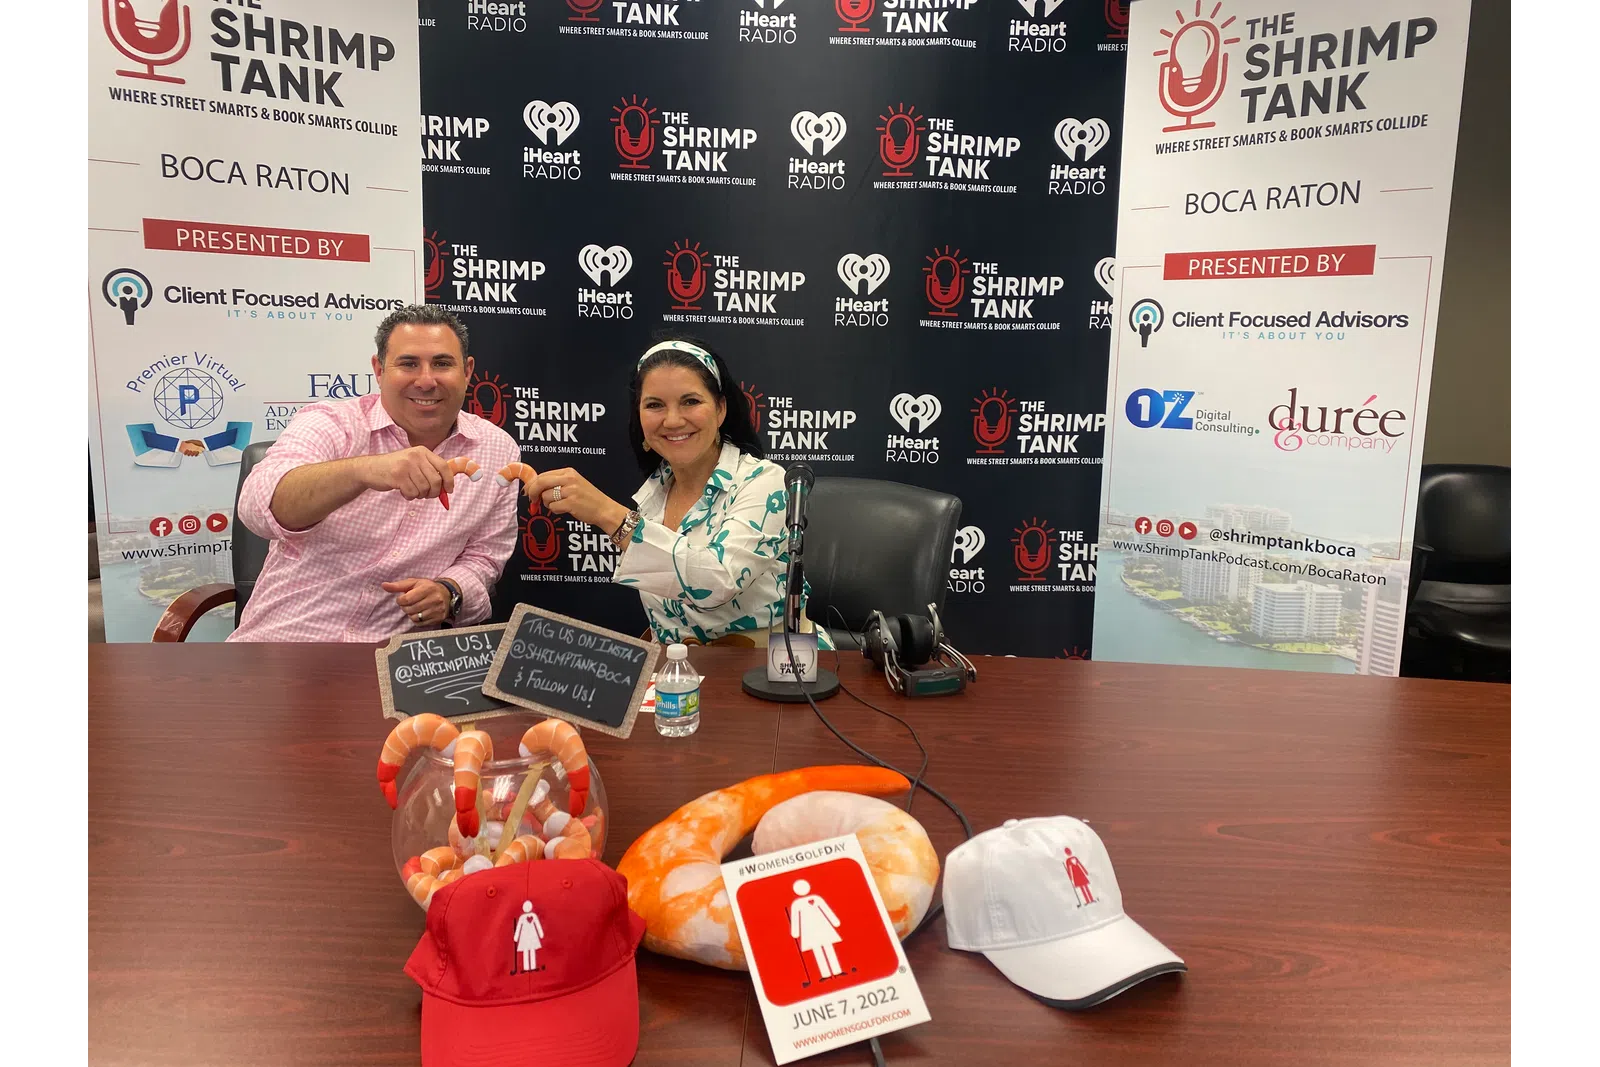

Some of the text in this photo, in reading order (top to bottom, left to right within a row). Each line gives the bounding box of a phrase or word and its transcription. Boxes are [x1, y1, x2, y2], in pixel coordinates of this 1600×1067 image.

[468, 0, 526, 16] iHeart
[612, 1, 680, 25] TANK
[467, 15, 527, 33] RADIO
[740, 9, 796, 29] iHeart
[882, 11, 949, 33] TANK
[1010, 19, 1067, 37] iHeart
[1246, 11, 1295, 40] THE
[210, 7, 396, 72] SHRIMP
[739, 27, 797, 44] RADIO
[829, 36, 851, 45] WHERE
[852, 37, 875, 46] STREET
[876, 37, 900, 46] SMARTS
[908, 38, 925, 46] BOOK
[926, 37, 950, 46] SMARTS
[952, 38, 977, 48] COLLIDE
[1008, 37, 1067, 52] RADIO
[1243, 16, 1438, 81] SHRIMP
[210, 51, 345, 108] TANK
[1240, 71, 1370, 124] TANK
[108, 86, 157, 106] WHERE
[160, 93, 206, 112] STREET
[209, 100, 258, 119] SMARTS
[273, 108, 305, 125] BOOK
[308, 114, 353, 131] SMARTS
[355, 119, 398, 137] COLLIDE
[662, 111, 689, 124] THE
[928, 117, 954, 131] THE
[662, 126, 758, 150] SHRIMP
[1155, 140, 1191, 155] WHERE
[1193, 136, 1231, 152] STREET
[1232, 131, 1277, 148] SMARTS
[1290, 125, 1322, 142] BOOK
[1325, 120, 1374, 138] SMARTS
[1376, 114, 1429, 132] COLLIDE
[926, 132, 1021, 158] SHRIMP
[523, 147, 580, 165] iHeart
[662, 150, 728, 173] TANK
[161, 153, 350, 196] BOCA RATON
[440, 165, 465, 174] SMARTS
[466, 166, 491, 175] COLLIDE
[523, 164, 581, 181] RADIO
[789, 157, 845, 175] iHeart
[925, 156, 991, 180] TANK
[1050, 164, 1106, 180] iHeart
[788, 174, 846, 190] RADIO
[873, 180, 895, 189] WHERE
[896, 181, 918, 189] STREET
[918, 181, 942, 190] SMARTS
[950, 182, 966, 191] BOOK
[967, 183, 991, 192] SMARTS
[992, 184, 1017, 194] COLLIDE
[1048, 179, 1106, 195] RADIO
[1185, 180, 1361, 215] BOCA RATON
[176, 228, 344, 257] PRESENTED BY
[451, 244, 478, 256] THE
[452, 258, 546, 281] SHRIMP
[713, 255, 739, 267] THE
[972, 262, 998, 275] THE
[1188, 253, 1346, 276] PRESENTED BY
[714, 269, 806, 291] SHRIMP
[972, 276, 1064, 297] SHRIMP
[164, 285, 404, 312] Client Focused Advisors
[452, 280, 517, 302] TANK
[578, 288, 632, 305] iHeart
[713, 291, 777, 313] TANK
[835, 297, 888, 313] iHeart
[970, 298, 1034, 319] TANK
[267, 310, 316, 320] ABOUT
[325, 312, 353, 321] YOU
[578, 304, 634, 320] RADIO
[662, 314, 684, 322] WHERE
[685, 315, 707, 323] STREET
[708, 315, 731, 323] SMARTS
[756, 317, 779, 325] SMARTS
[780, 318, 804, 326] COLLIDE
[834, 313, 889, 327] RADIO
[1172, 310, 1409, 328] Client Focused Advisors
[1258, 332, 1306, 341] ABOUT
[1315, 332, 1346, 341] YOU
[126, 351, 247, 393] Premier Virtual
[513, 387, 539, 399] THE
[768, 396, 793, 408] THE
[515, 400, 606, 422] SHRIMP
[1019, 401, 1045, 412] THE
[1196, 409, 1231, 422] Digital
[1268, 387, 1406, 438] durée
[768, 409, 857, 429] SHRIMP
[1018, 413, 1106, 432] SHRIMP
[514, 421, 578, 442] TANK
[767, 430, 829, 450] TANK
[887, 434, 939, 450] iHeart
[1017, 434, 1080, 453] TANK
[1306, 433, 1397, 454] company
[886, 450, 939, 464] RADIO
[967, 457, 987, 465] WHERE
[988, 457, 1009, 465] STREET
[1010, 457, 1033, 465] SMARTS
[1040, 457, 1056, 465] BOOK
[566, 520, 592, 532] THE
[1059, 530, 1084, 541] THE
[1209, 528, 1356, 558] @shrimptankboca
[1113, 538, 1387, 586] www.ShrimpTankPodcast.com/BocaRaton
[564, 575, 587, 583] SMARTS
[949, 567, 985, 580] eart
[946, 580, 985, 593] ADIO
[524, 618, 555, 639] TAG
[558, 627, 575, 645] US
[578, 634, 597, 649] ON
[401, 633, 492, 661] TAG US!
[792, 985, 899, 1030] JUNE 7, 2022
[793, 1009, 911, 1049] WWW.WOMENSGOLFDAY.COM
